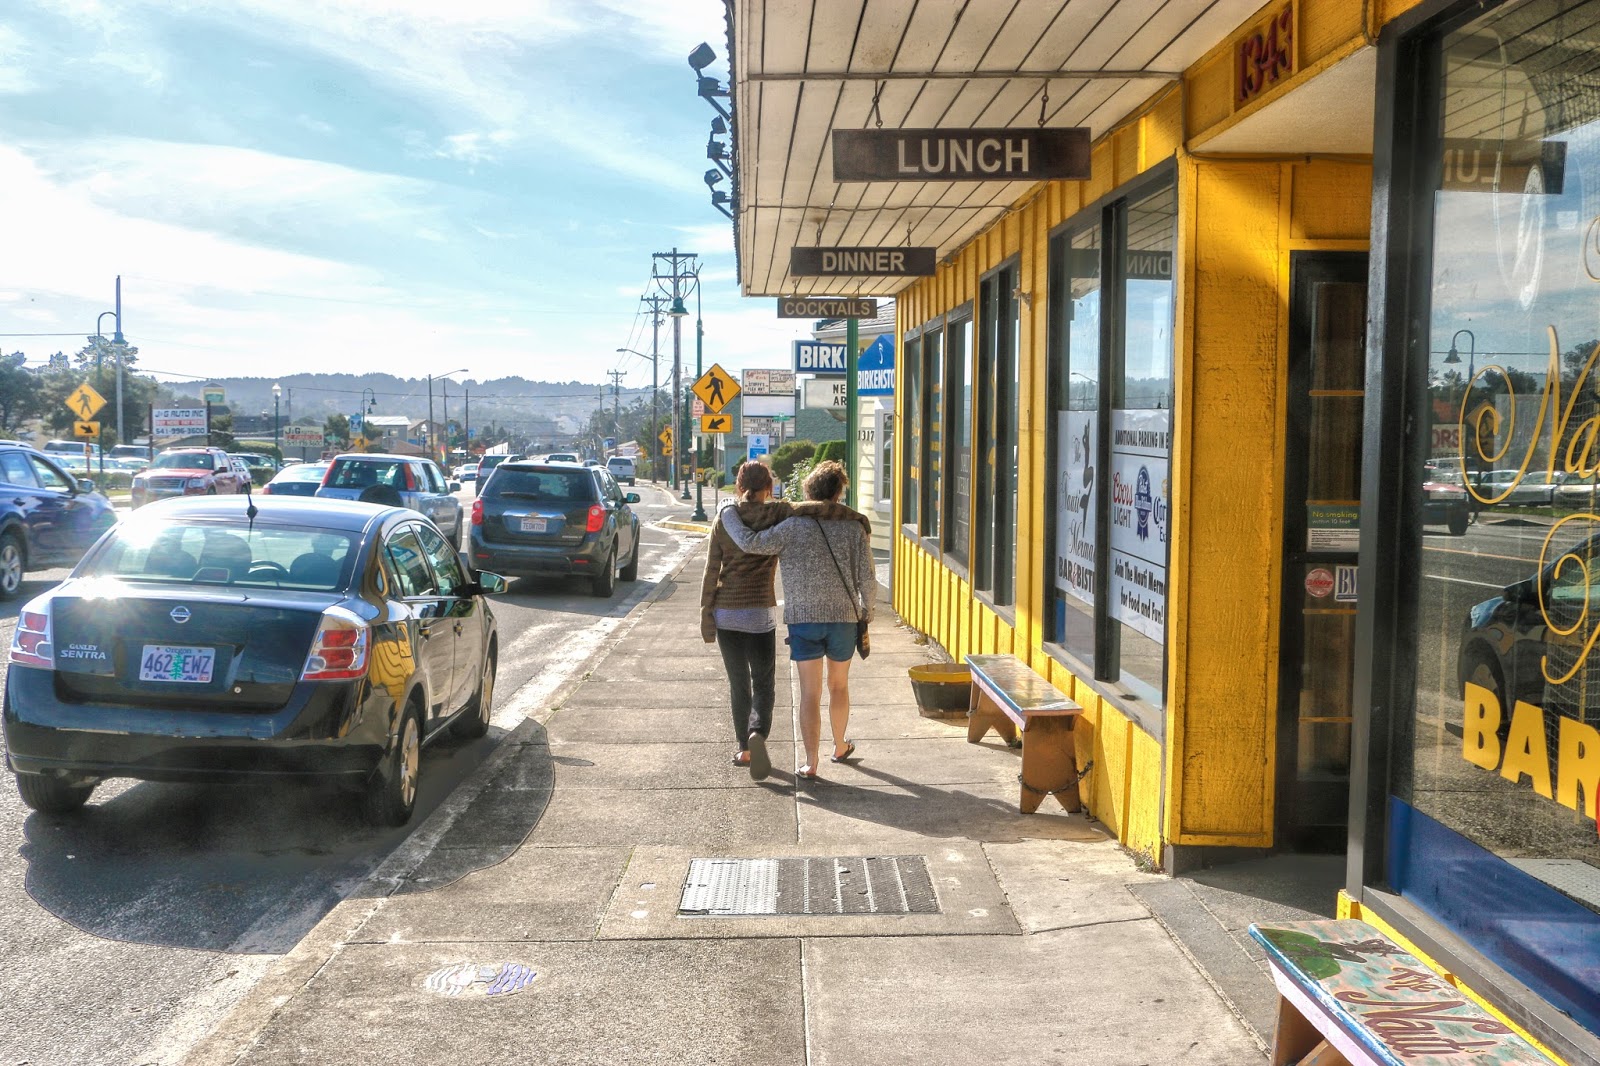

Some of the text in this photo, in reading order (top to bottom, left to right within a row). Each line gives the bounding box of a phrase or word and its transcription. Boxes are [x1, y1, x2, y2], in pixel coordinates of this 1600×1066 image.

[1239, 5, 1293, 102] 1343
[898, 138, 1029, 173] LUNCH
[822, 252, 905, 272] DINNER
[784, 301, 871, 316] COCKTAILS
[858, 430, 875, 441] 1317
[1138, 430, 1158, 448] PARKING
[1159, 431, 1165, 449] IN
[1112, 472, 1133, 506] Coors
[1113, 506, 1132, 528] LIGHT
[1326, 511, 1358, 520] smoking
[1114, 558, 1124, 578] Join
[1124, 560, 1133, 581] The
[1133, 565, 1148, 588] Nauti
[1120, 586, 1164, 625] for Food and Fun!
[60, 649, 107, 660] SENTRA
[165, 647, 192, 655] Oregon
[144, 653, 212, 674] 462 EWZ
[1463, 680, 1600, 819] BAR
